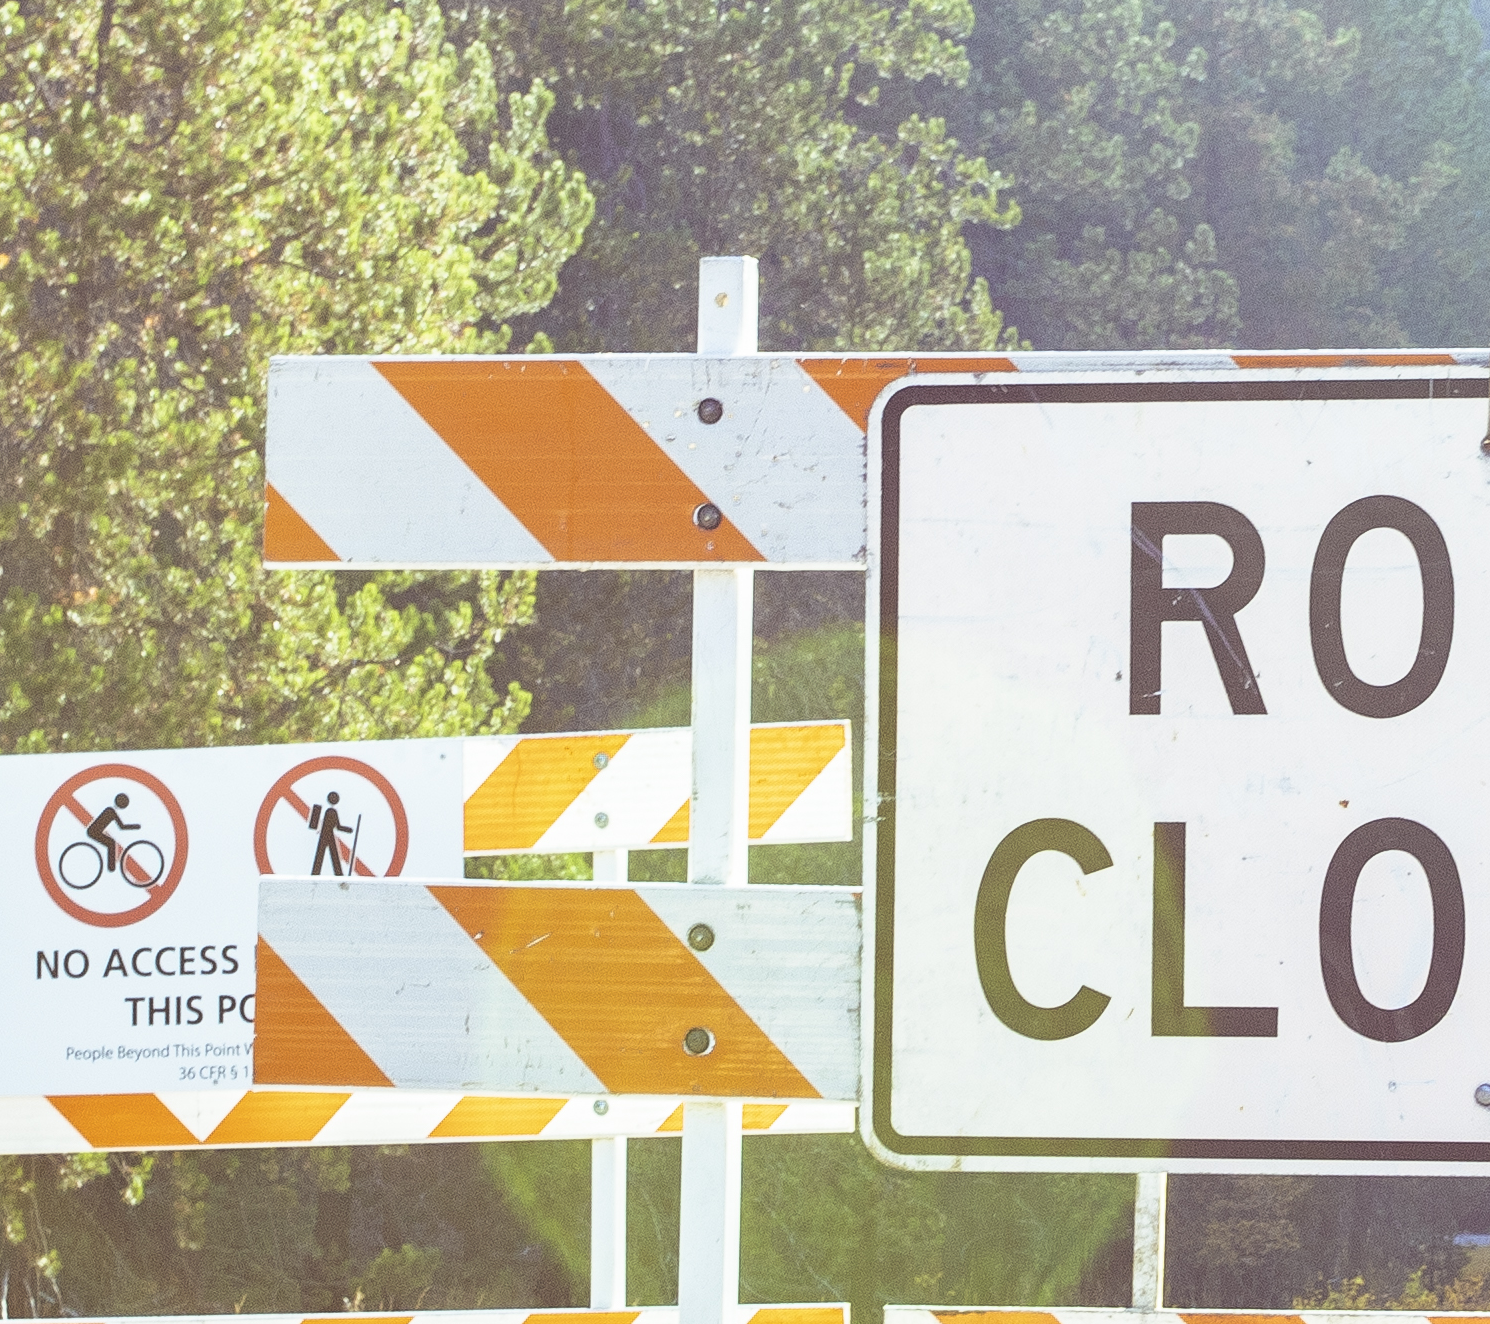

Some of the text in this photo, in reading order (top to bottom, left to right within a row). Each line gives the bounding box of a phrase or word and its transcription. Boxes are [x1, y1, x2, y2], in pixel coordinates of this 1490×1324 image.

[36, 948, 90, 980] NO
[102, 944, 239, 978] ACCESS
[124, 994, 204, 1027] THIS
[66, 1045, 113, 1063] People
[117, 1044, 170, 1063] Beyond
[173, 1043, 201, 1058] This
[205, 1041, 241, 1057] Point
[179, 1066, 196, 1081] 36
[199, 1065, 226, 1079] CFR
